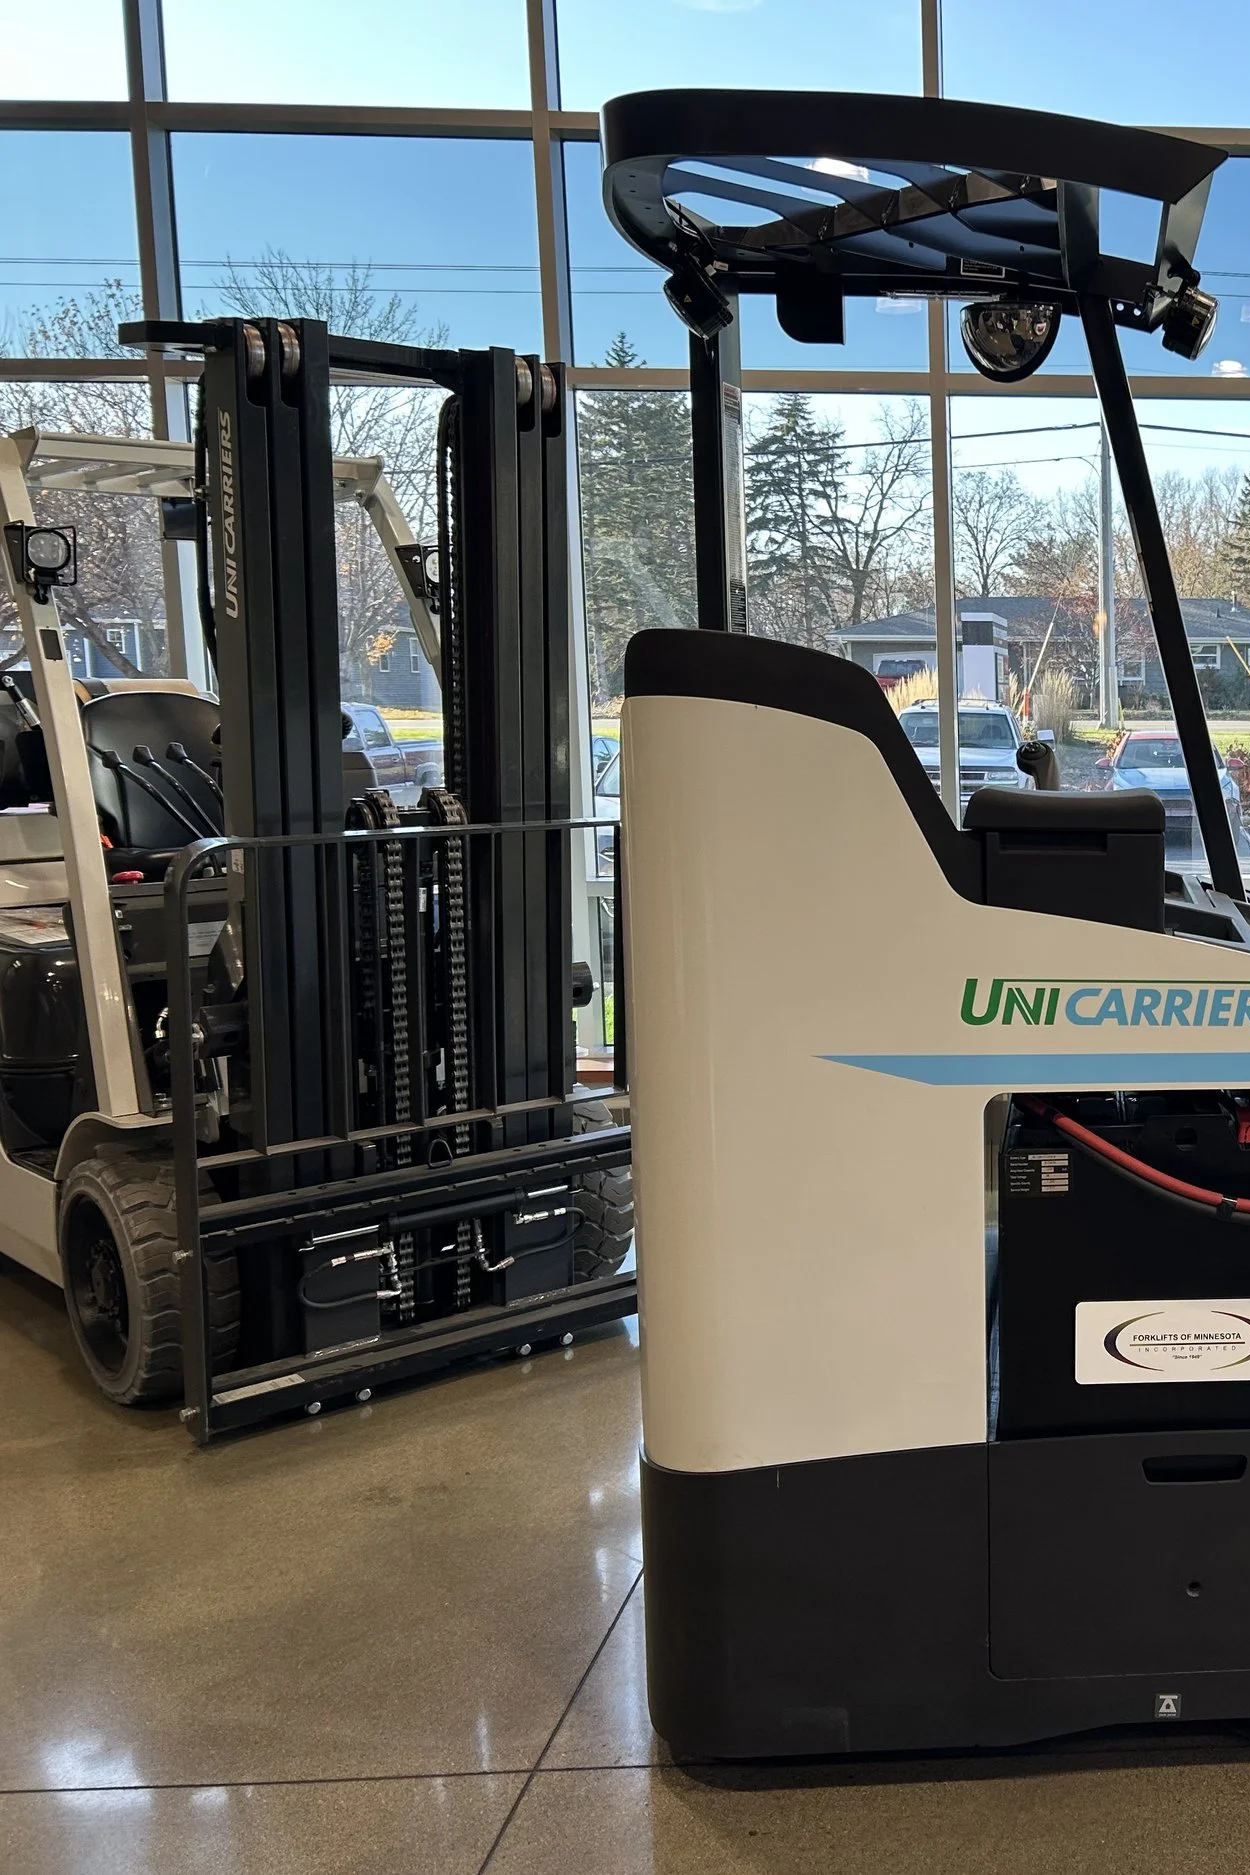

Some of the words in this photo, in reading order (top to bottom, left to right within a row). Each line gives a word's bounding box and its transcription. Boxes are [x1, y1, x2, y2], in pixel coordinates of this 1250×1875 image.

[217, 407, 239, 619] UNICARRIERS
[1132, 1334, 1178, 1342] FORKLIFTS
[1180, 1333, 1192, 1341] OF
[1194, 1332, 1242, 1340] MINNESOTA
[1138, 1345, 1236, 1353] INCORPORATED
